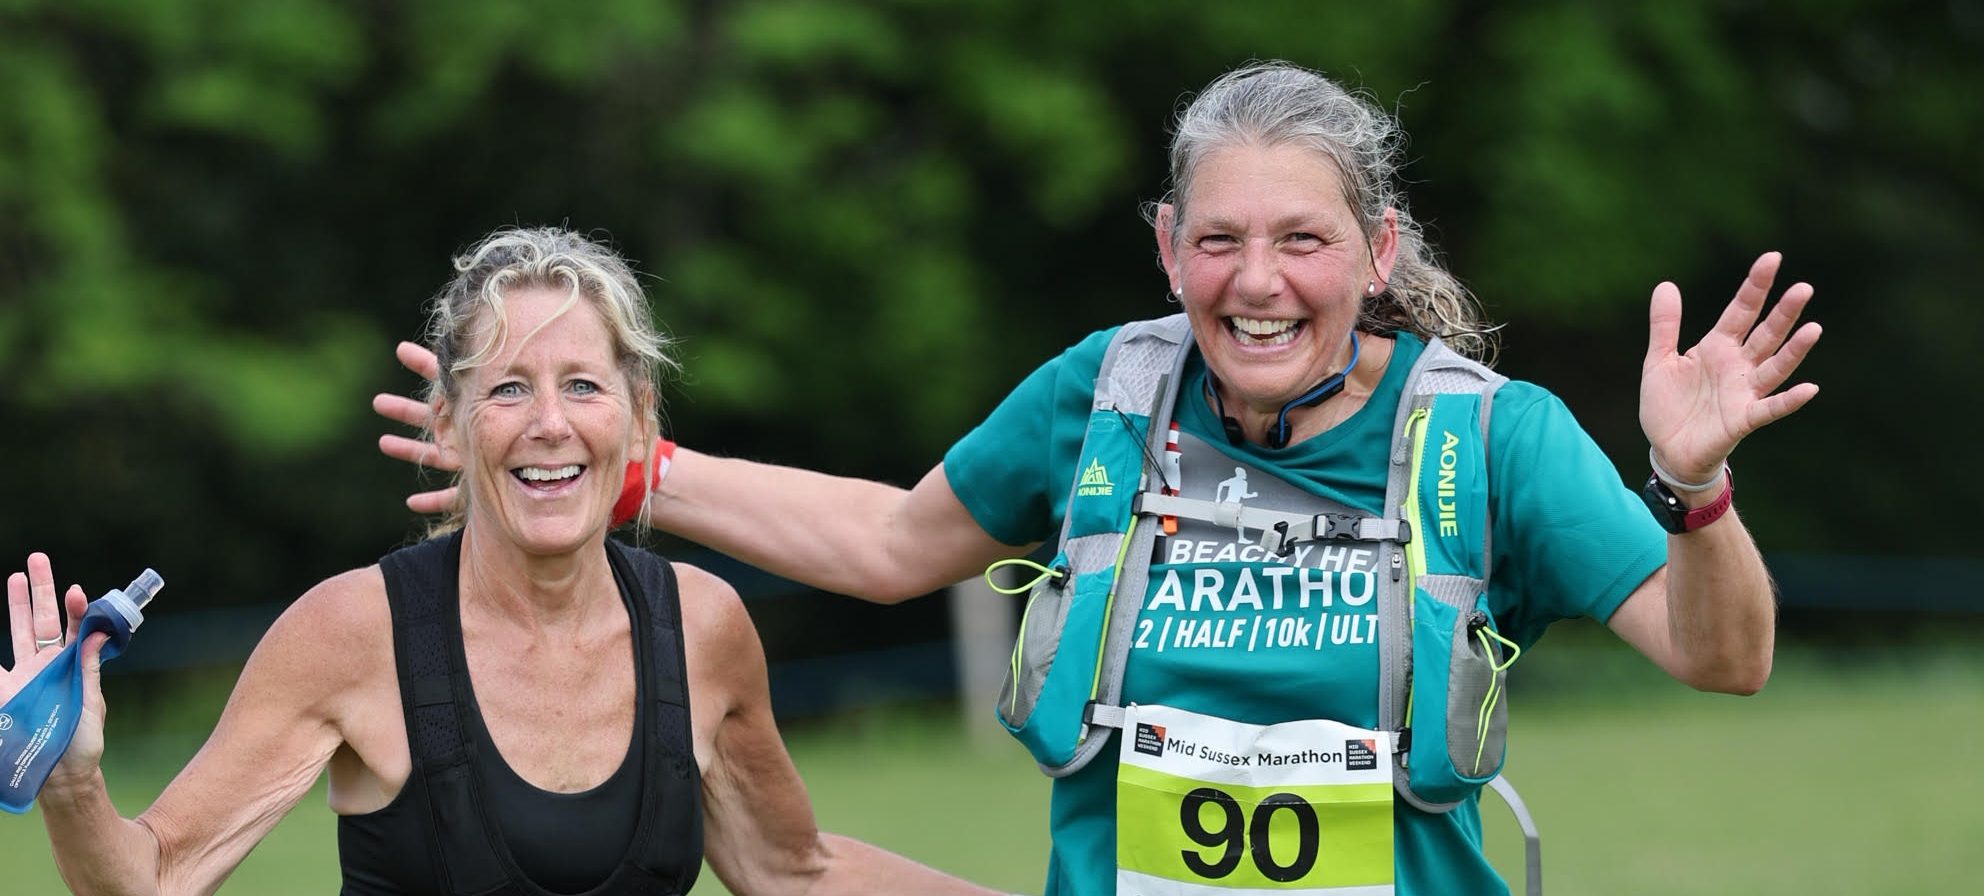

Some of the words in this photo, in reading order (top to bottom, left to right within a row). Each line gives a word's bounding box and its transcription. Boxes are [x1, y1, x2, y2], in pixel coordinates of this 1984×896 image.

[1438, 430, 1459, 537] AONIJIE
[1319, 545, 1379, 573] HE
[1139, 567, 1375, 611] ARATHO
[1129, 619, 1154, 649] .2
[1173, 619, 1247, 648] HALF
[1265, 617, 1312, 648] 10k
[1331, 614, 1379, 645] ULT
[1167, 738, 1196, 756] Mid
[1199, 746, 1250, 766] Sussex
[1258, 750, 1342, 766] Marathon
[1180, 787, 1319, 882] 90
